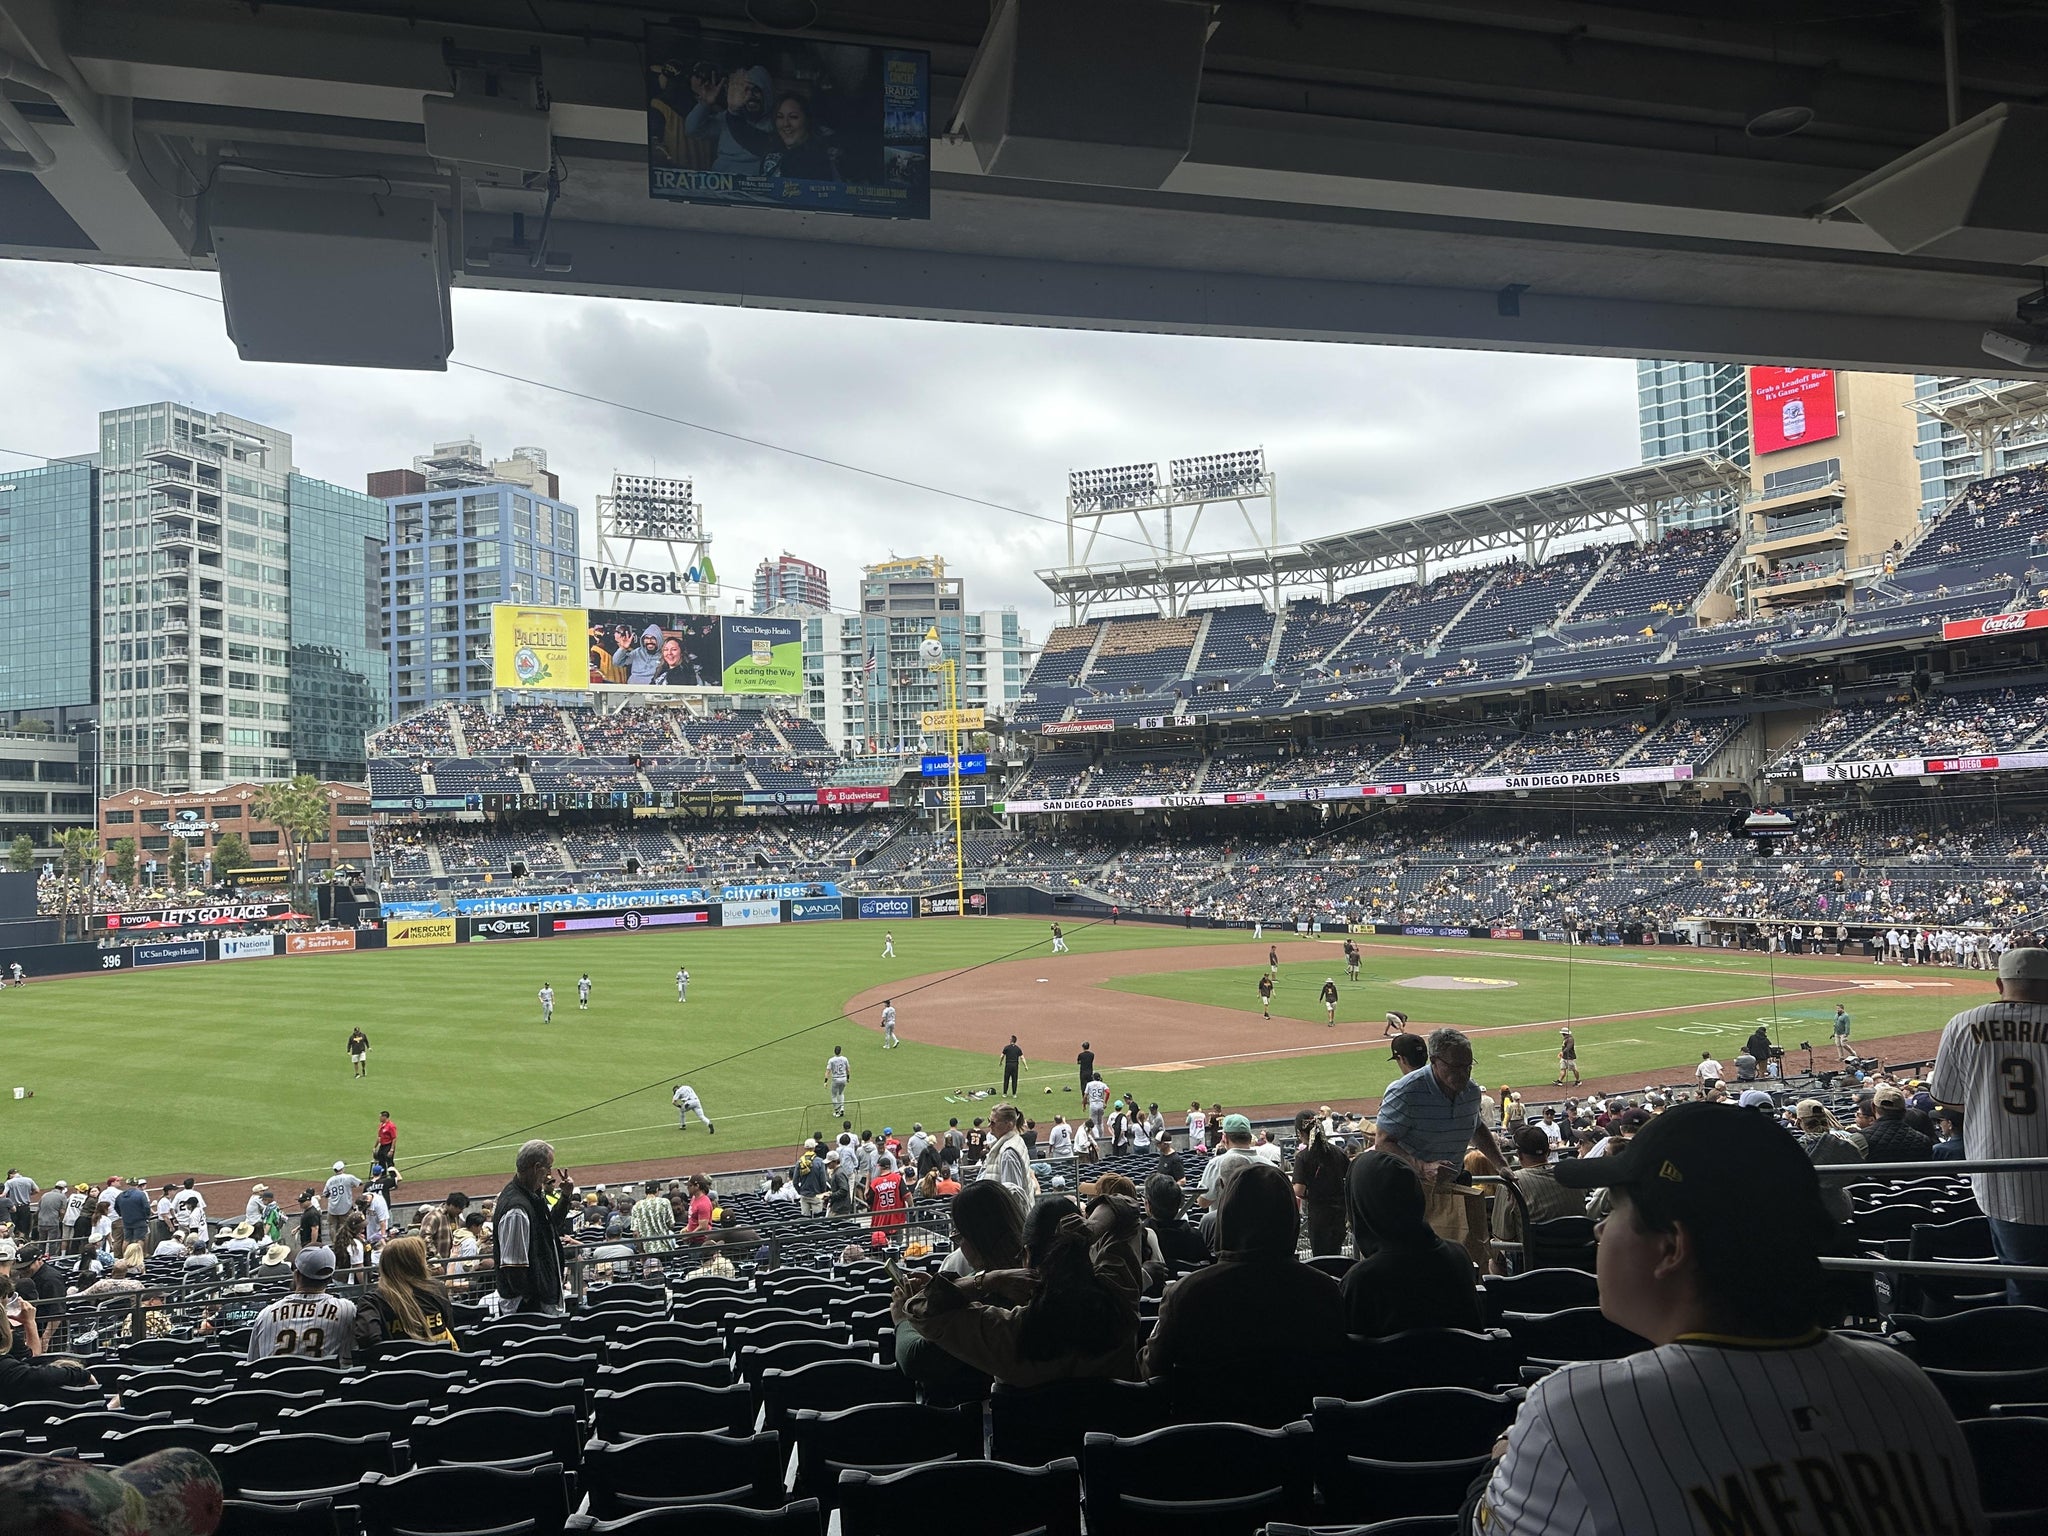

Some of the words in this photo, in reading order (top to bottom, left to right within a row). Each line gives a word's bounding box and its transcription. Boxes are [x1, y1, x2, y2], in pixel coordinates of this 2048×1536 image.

[884, 86, 920, 97] IRATION
[653, 171, 733, 192] IRATION
[1756, 385, 1774, 396] Grab
[1781, 375, 1811, 390] Leadoff
[1811, 370, 1829, 380] Bud.
[1765, 391, 1777, 401] It's
[1777, 386, 1800, 397] Game
[1800, 381, 1820, 392] Time
[589, 566, 681, 594] Viasat
[732, 625, 742, 633] UC
[743, 626, 755, 634] San
[755, 626, 772, 636] Diego
[772, 627, 791, 635] Health
[515, 628, 567, 647] PACIFICO
[734, 668, 765, 677] Leading
[766, 668, 779, 676] the
[779, 669, 796, 678] Way
[743, 678, 757, 686] San
[758, 678, 777, 686] Diego
[1174, 715, 1196, 726] 12:50
[1044, 723, 1082, 734] Tarantino
[1082, 723, 1113, 732] SAUSAGES
[934, 761, 963, 769] LANDCAE
[1943, 761, 1958, 770] SAN
[1959, 759, 1982, 769] DIEGO
[1850, 763, 1895, 779] USAA
[1505, 777, 1529, 788] SAN
[1532, 774, 1569, 786] DIEGO
[1572, 772, 1620, 784] PADRES
[1436, 781, 1469, 794] USAA
[478, 794, 484, 803] 3
[515, 794, 521, 803] 3
[839, 791, 881, 801] Budweiser
[1175, 795, 1205, 807] USAA
[478, 803, 484, 811] 4
[491, 798, 496, 807] F
[515, 803, 521, 811] 4
[1043, 801, 1064, 811] SAN
[1066, 799, 1094, 809] DIEGO
[1096, 798, 1133, 808] PADRES
[166, 821, 210, 832] Gallagher
[172, 829, 204, 838] Square
[753, 907, 770, 916] blue
[804, 904, 841, 912] VANDA
[876, 900, 908, 913] petco
[122, 915, 151, 924] TOYOTA
[161, 909, 195, 924] LET'S
[198, 908, 220, 922] GO
[223, 904, 268, 920] PLACES
[724, 910, 743, 919] blue
[410, 925, 451, 933] MERCURY
[478, 920, 530, 933] EVOTEK
[1413, 926, 1434, 935] petco
[1448, 927, 1469, 936] petco
[410, 931, 452, 939] INSURANCE
[239, 940, 270, 949] National
[308, 940, 331, 948] Safari
[332, 939, 349, 947] Park
[140, 951, 150, 959] UC
[151, 950, 163, 958] San
[163, 949, 179, 959] Diego
[180, 947, 199, 956] Health
[102, 954, 121, 969] 396
[1970, 1019, 2048, 1045] MERRIL
[2000, 1057, 2038, 1116] 3
[1092, 1088, 1103, 1098] 25
[1061, 1128, 1068, 1139] 5
[331, 1184, 345, 1197] 88
[875, 1181, 898, 1193] THOMAS
[70, 1199, 82, 1209] 20
[879, 1191, 895, 1207] 35
[1874, 1279, 1890, 1291] petco
[1878, 1286, 1891, 1297] park
[271, 1303, 316, 1323] TATIS
[317, 1302, 339, 1322] JR.
